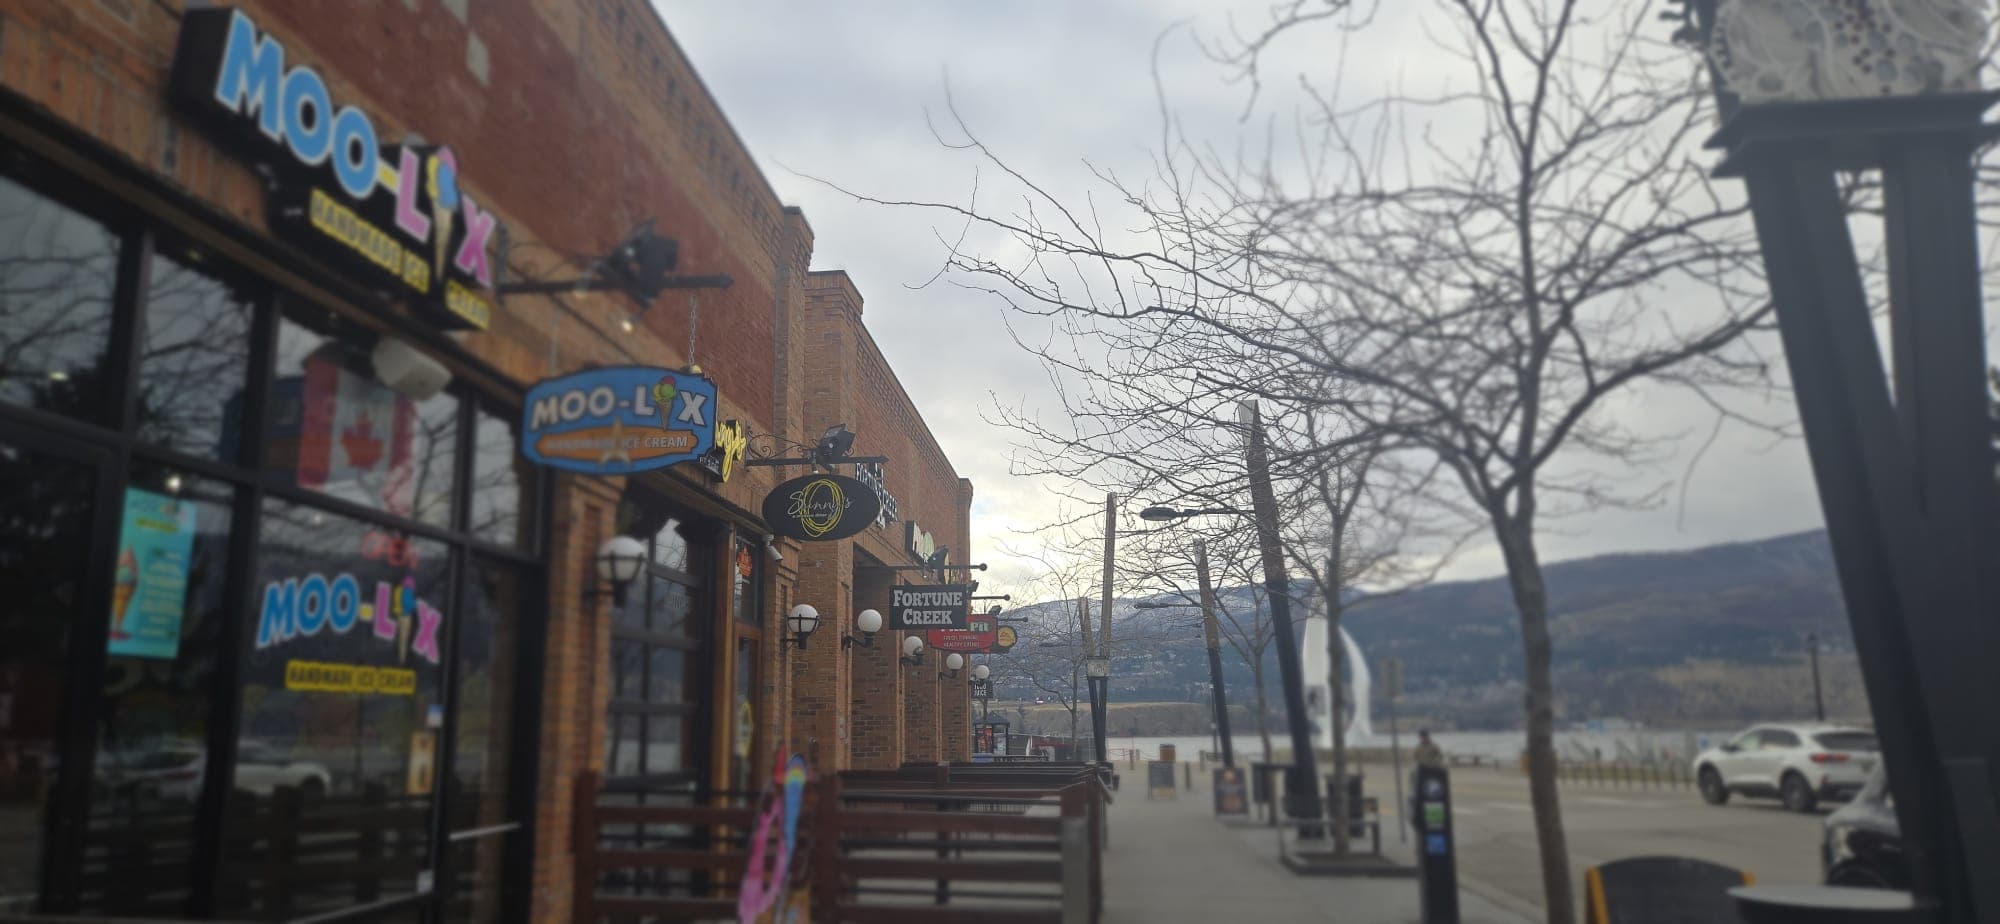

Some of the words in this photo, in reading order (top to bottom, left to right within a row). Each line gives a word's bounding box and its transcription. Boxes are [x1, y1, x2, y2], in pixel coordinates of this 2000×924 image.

[644, 436, 688, 449] CREAM
[892, 589, 963, 608] FORTUNE
[902, 608, 953, 625] CREEK
